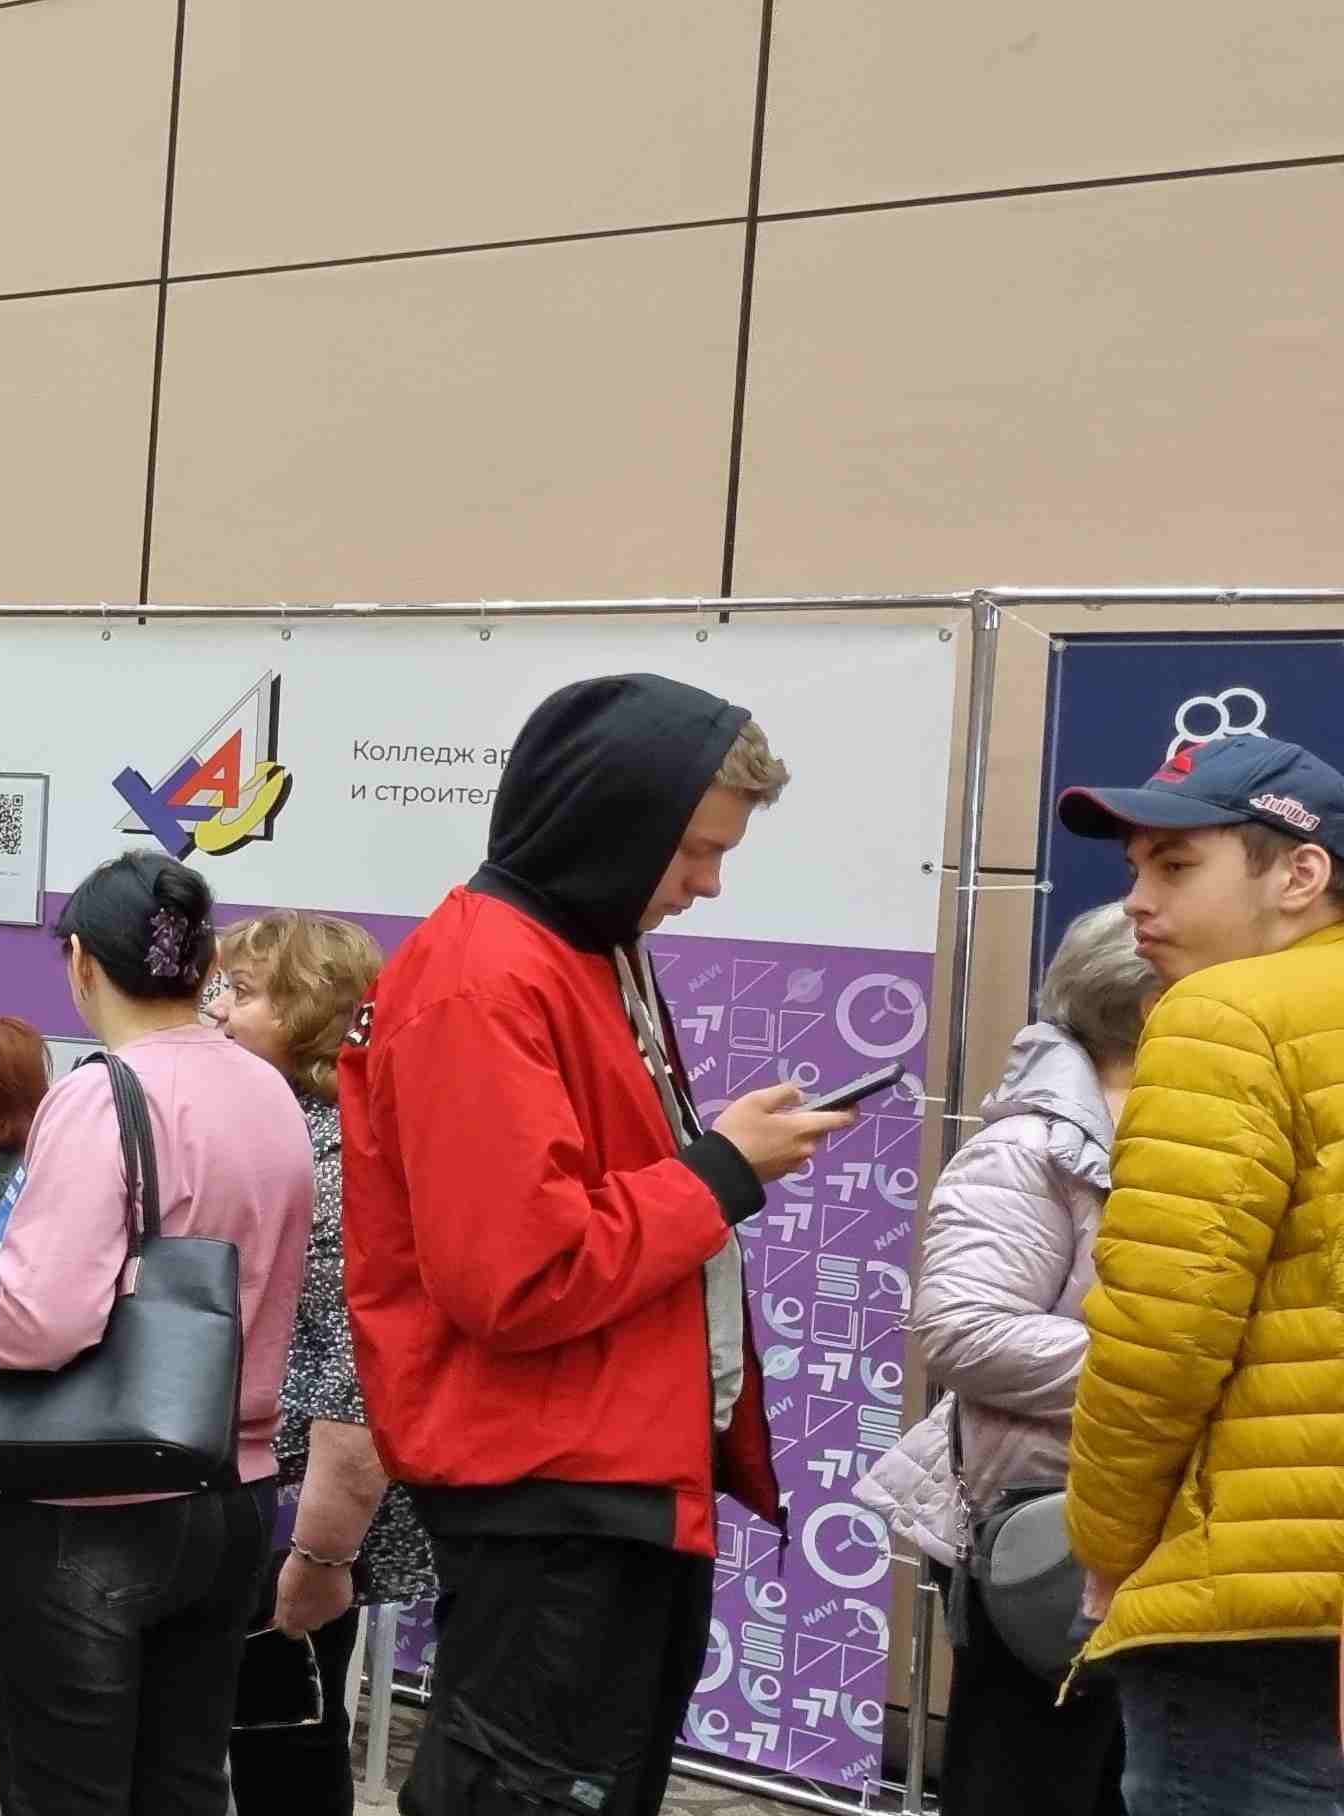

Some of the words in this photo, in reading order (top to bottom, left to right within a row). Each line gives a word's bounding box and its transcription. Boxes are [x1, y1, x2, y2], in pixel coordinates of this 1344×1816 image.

[353, 740, 475, 766] Колледж
[351, 784, 366, 799] и
[874, 1222, 912, 1250] NAVI
[801, 1600, 839, 1627] NAVI
[840, 1754, 878, 1780] NAVI
